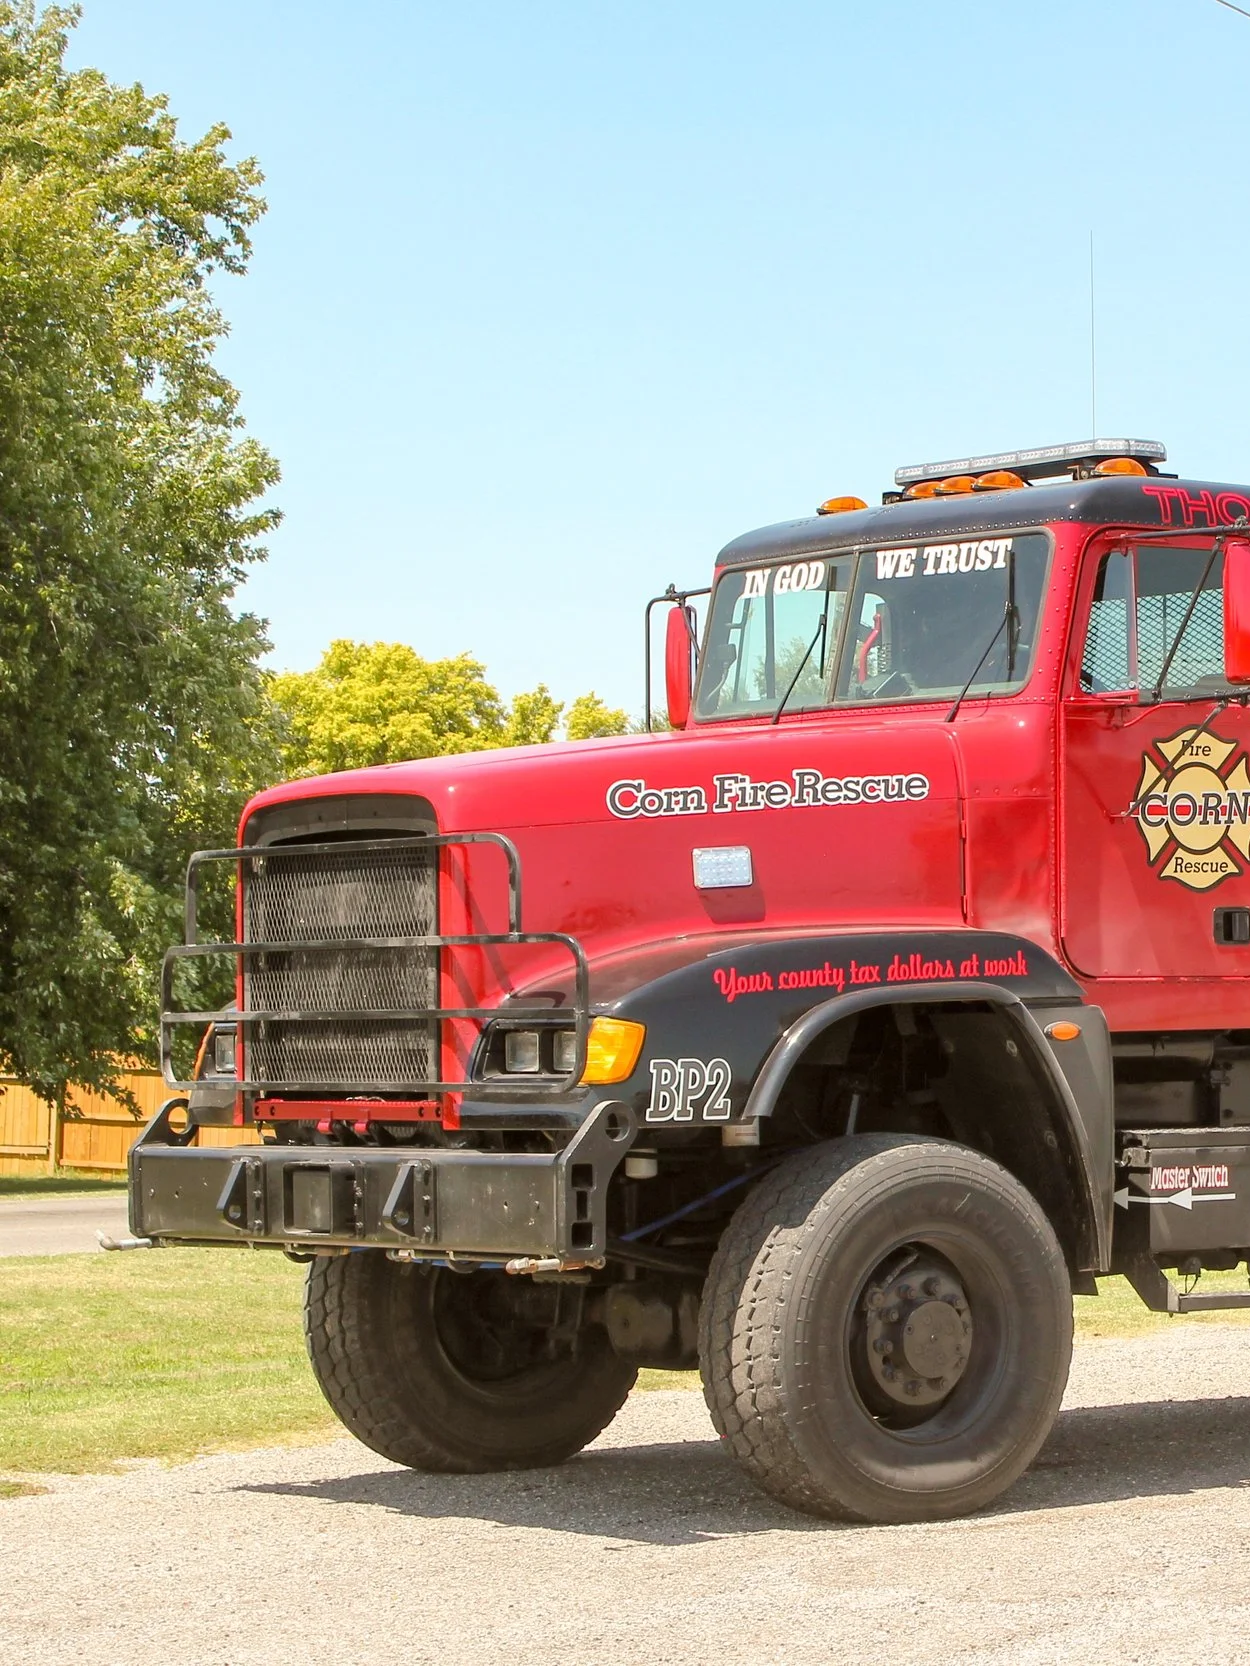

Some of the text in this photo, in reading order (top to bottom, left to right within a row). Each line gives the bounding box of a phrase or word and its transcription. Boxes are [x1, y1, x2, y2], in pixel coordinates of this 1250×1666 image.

[742, 561, 825, 598] IN GOD
[876, 538, 1013, 580] WE TRUST
[606, 768, 929, 818] Corn Fire Rescue
[1173, 857, 1229, 873] Rescue
[713, 950, 1028, 1003] Your county tax dollars at work
[646, 1058, 732, 1122] BP2
[1151, 1165, 1229, 1189] Master Switch
